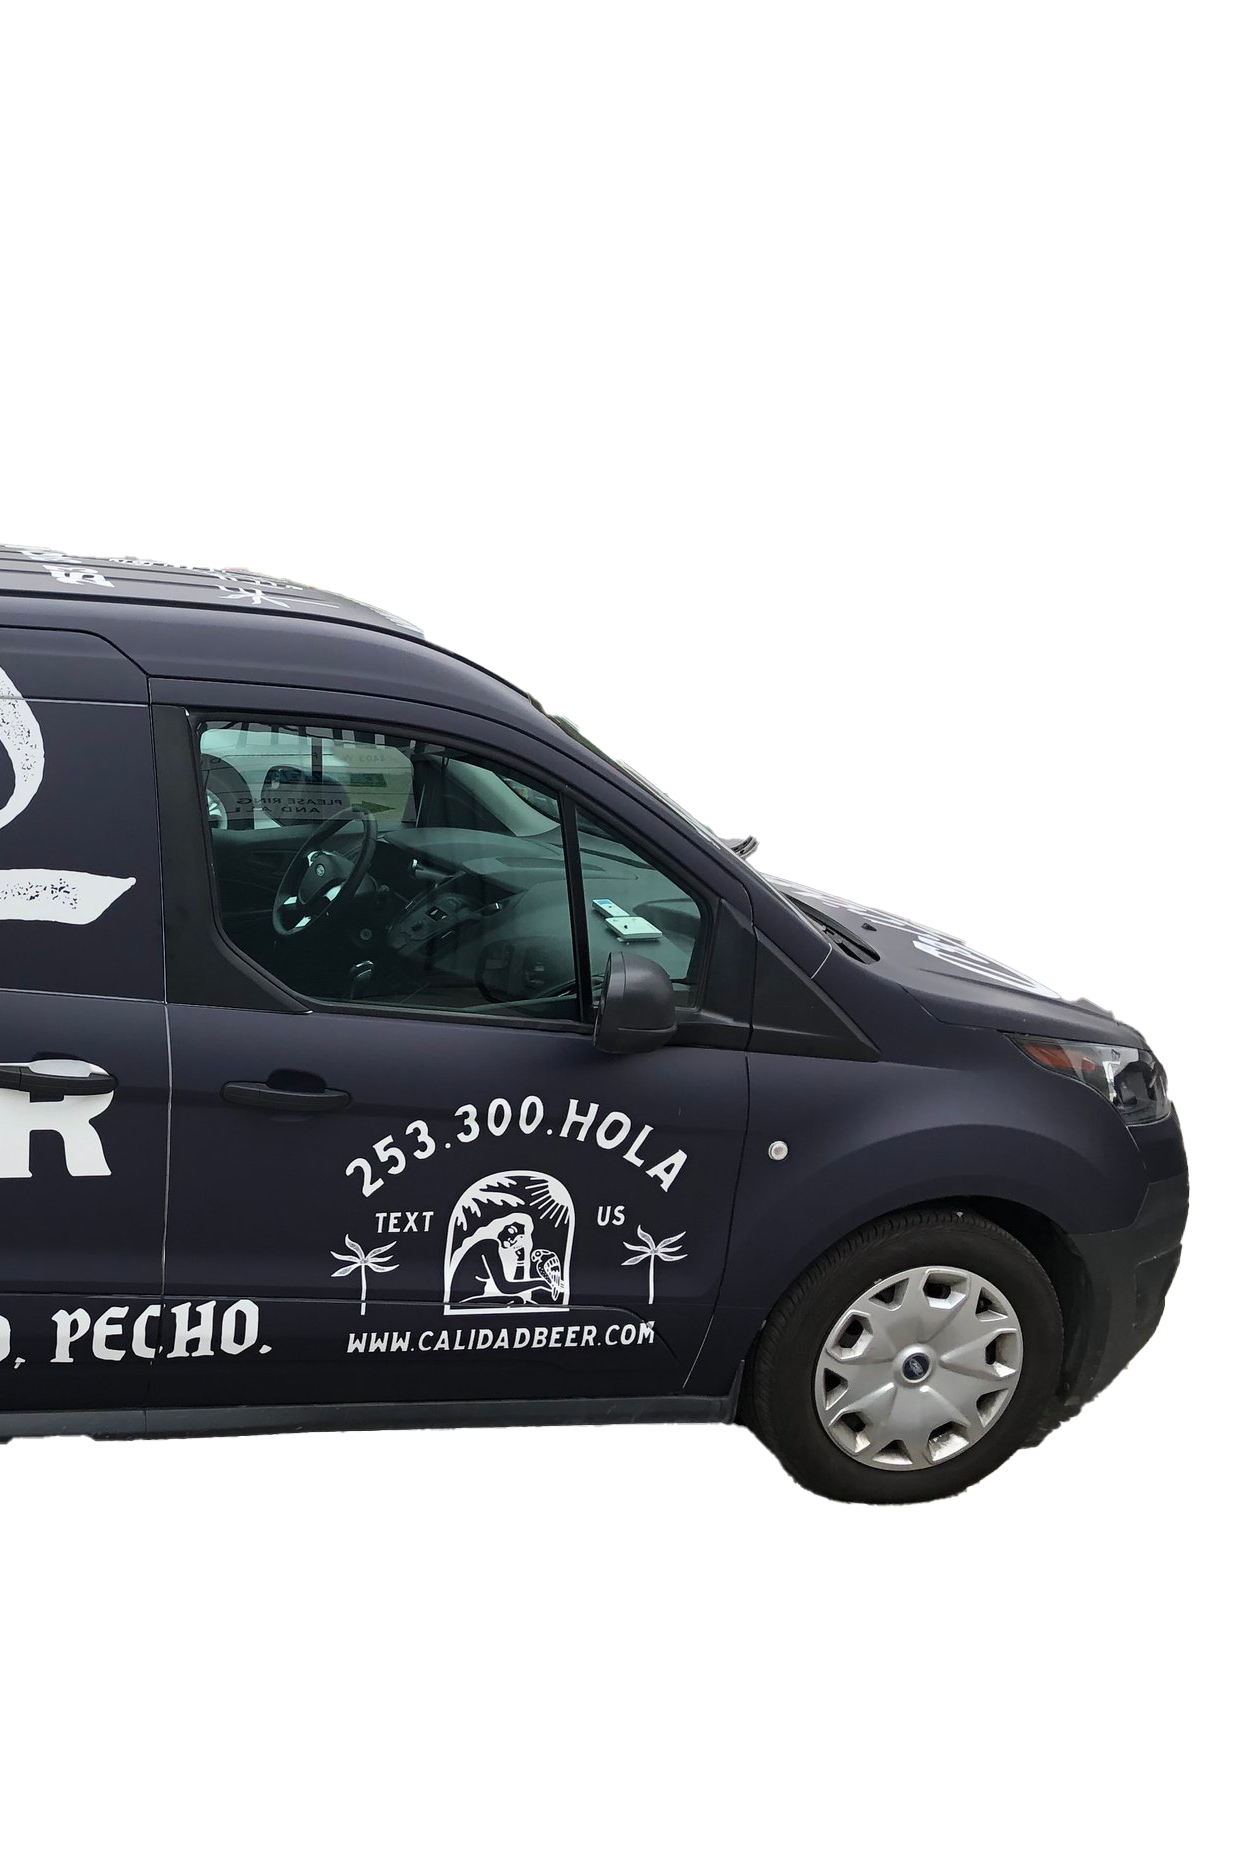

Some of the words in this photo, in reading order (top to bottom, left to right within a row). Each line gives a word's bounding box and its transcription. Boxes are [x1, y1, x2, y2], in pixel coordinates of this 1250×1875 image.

[346, 1095, 688, 1198] 253.300.HOLA
[375, 1211, 434, 1234] TEXT
[597, 1205, 625, 1226] US
[50, 1299, 272, 1364] PECHO.
[346, 1320, 655, 1353] WWW.CALIDADBEER.COM
